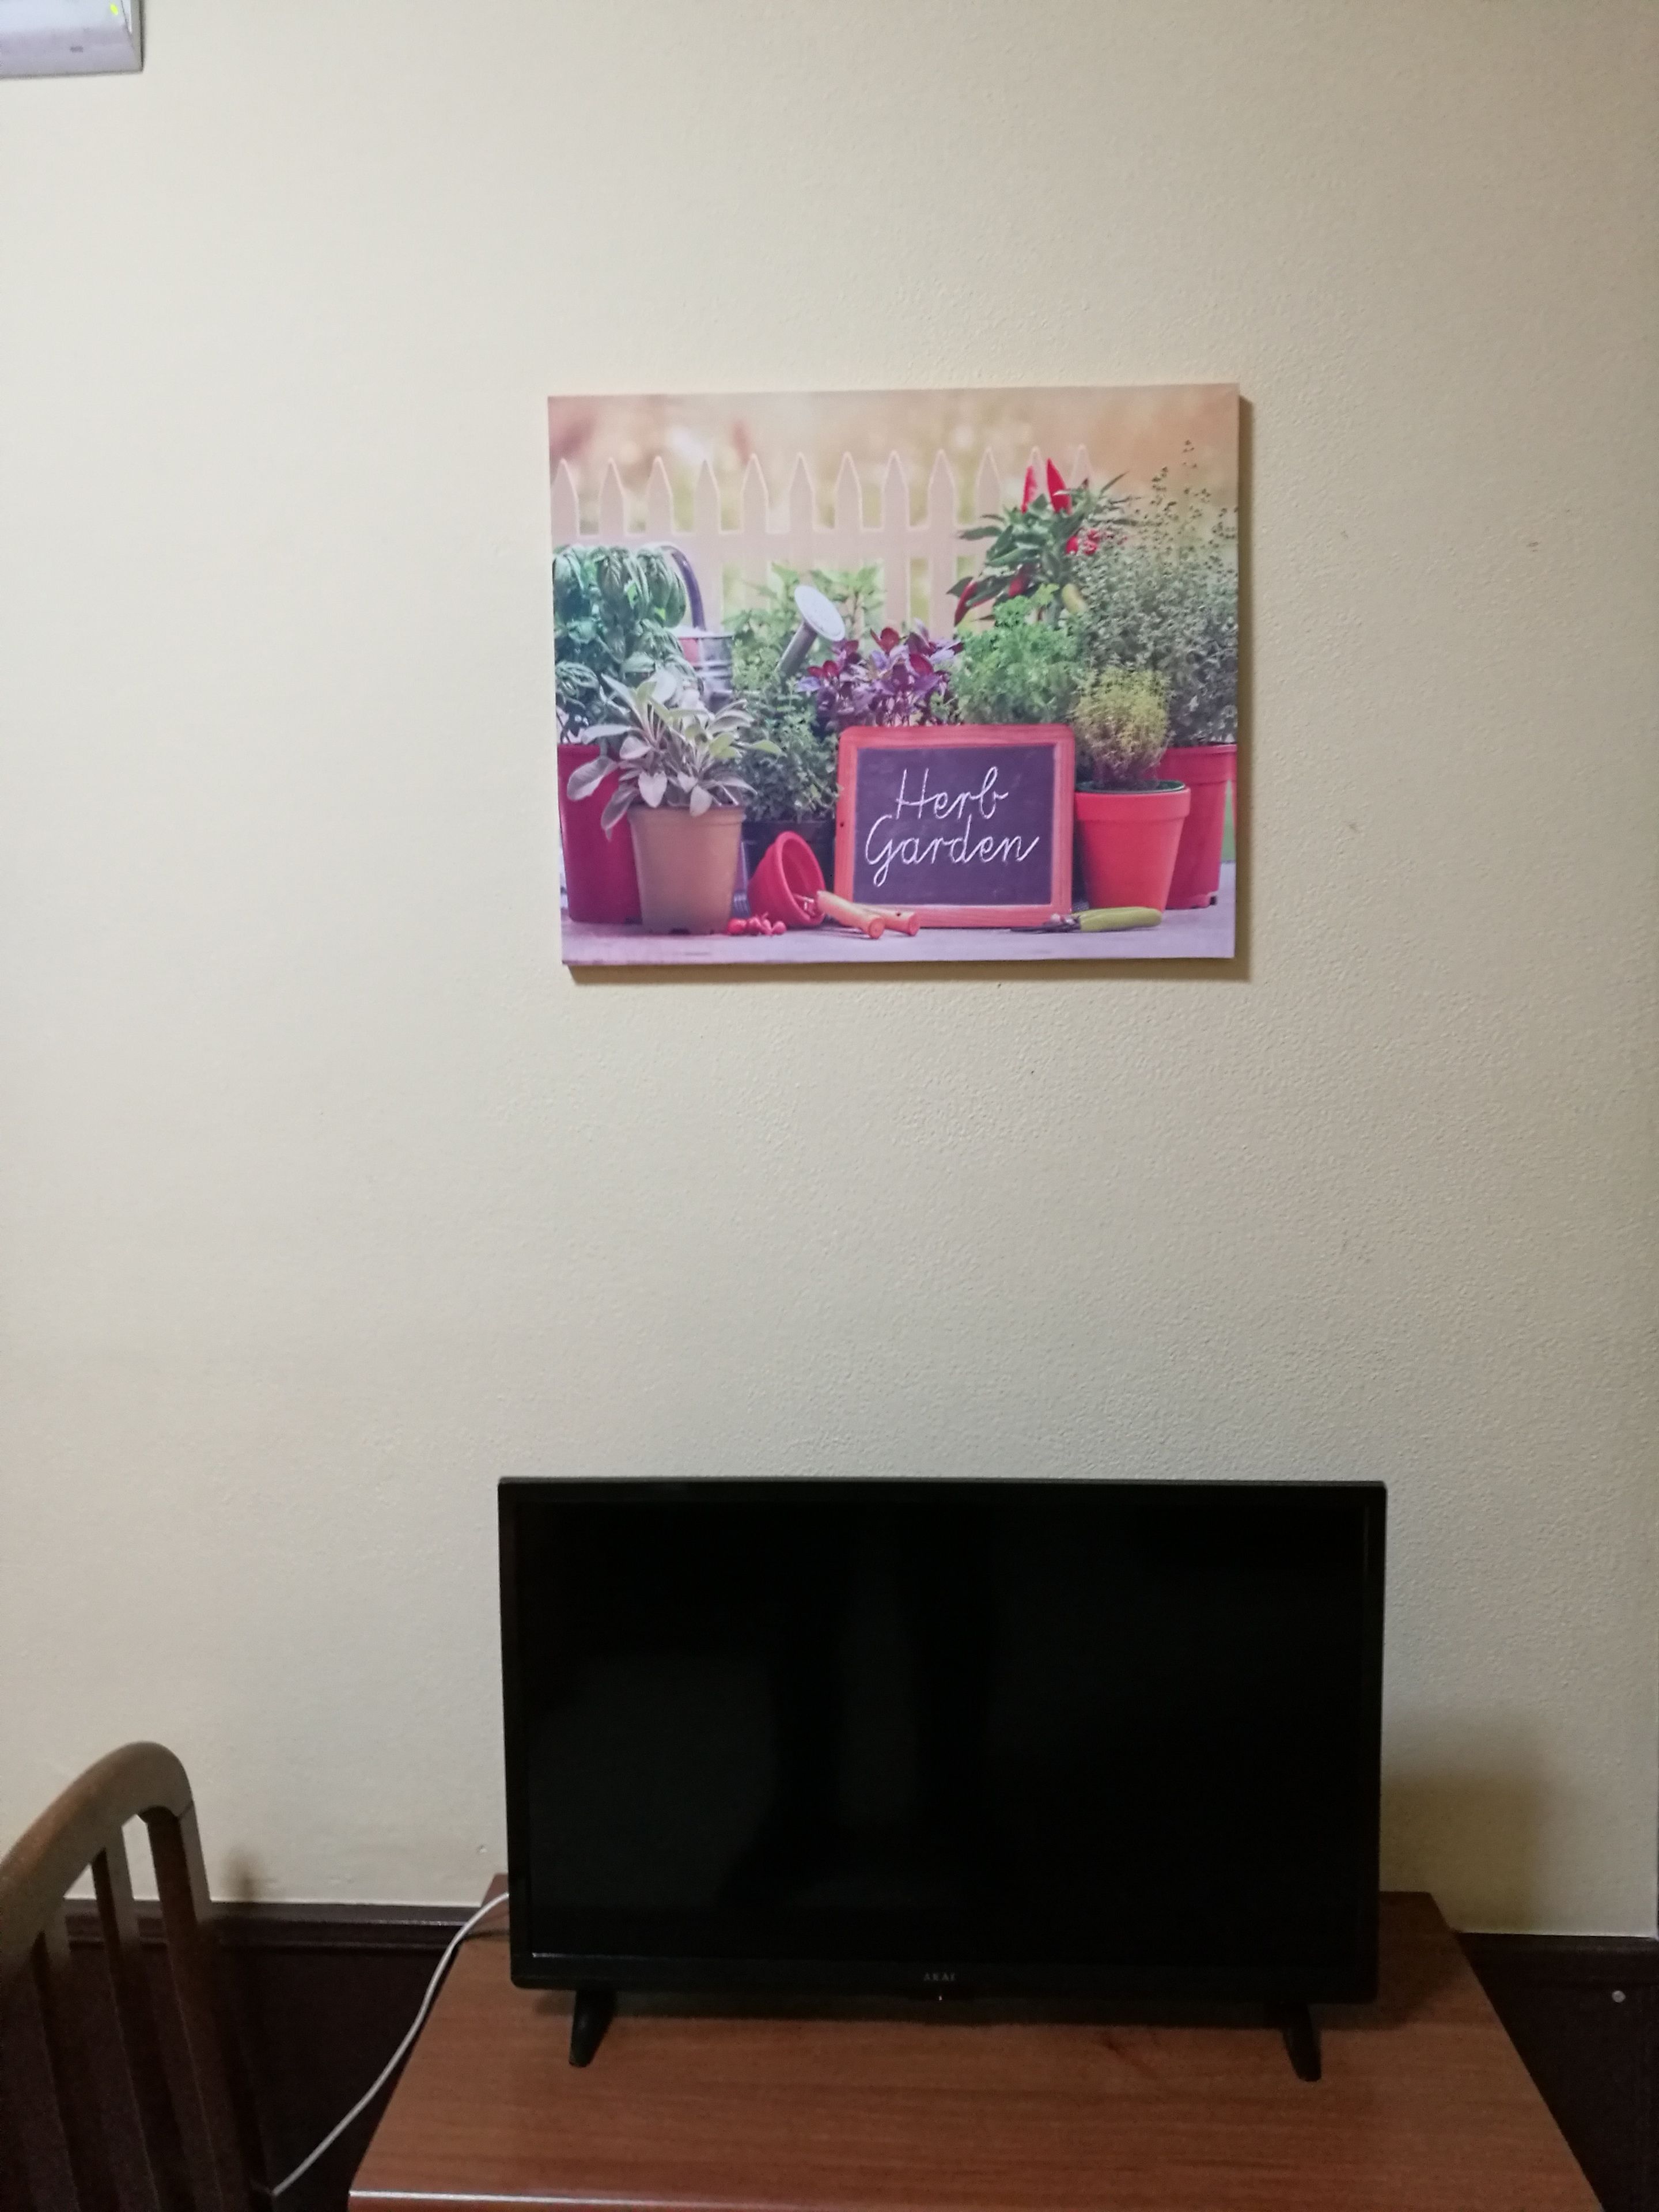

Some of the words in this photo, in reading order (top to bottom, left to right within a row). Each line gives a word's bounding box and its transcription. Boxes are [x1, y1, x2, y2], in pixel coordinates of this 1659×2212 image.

[896, 766, 1009, 820] Herb
[865, 813, 1040, 888] Garden
[923, 1972, 956, 1982] AKAI
